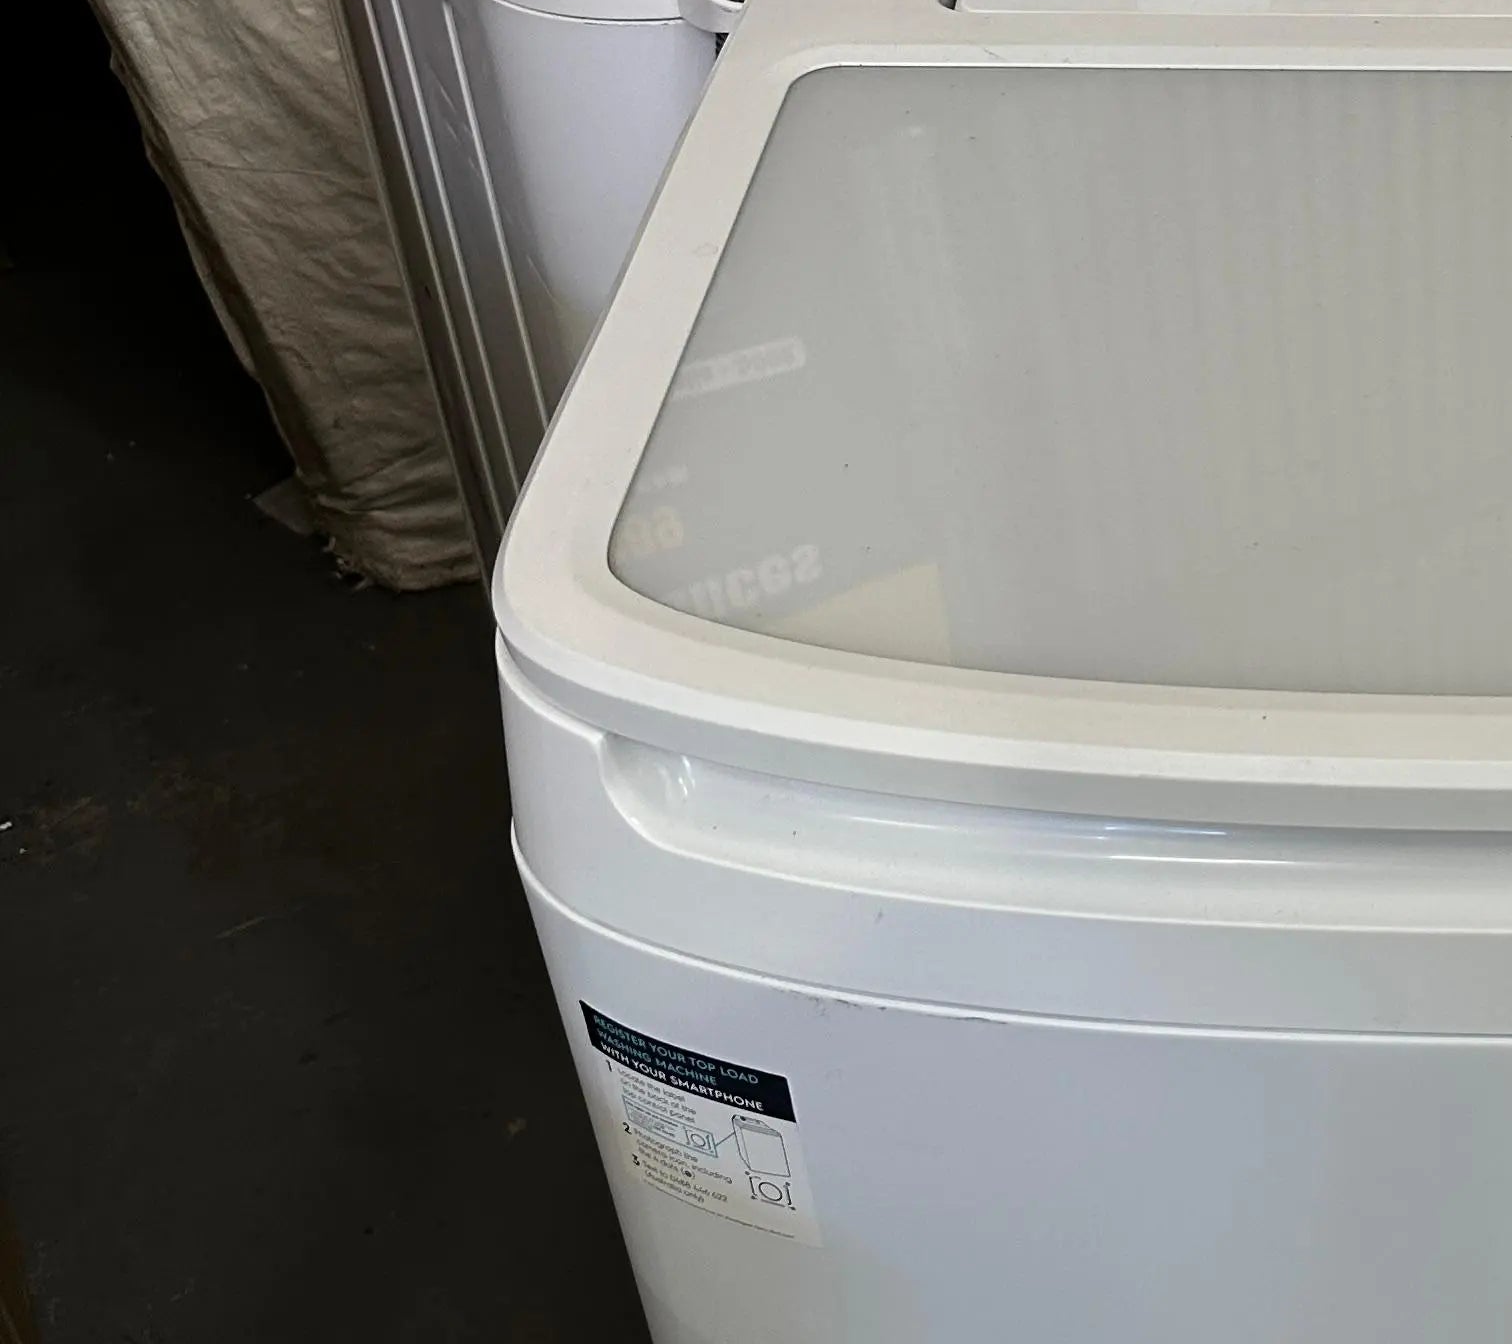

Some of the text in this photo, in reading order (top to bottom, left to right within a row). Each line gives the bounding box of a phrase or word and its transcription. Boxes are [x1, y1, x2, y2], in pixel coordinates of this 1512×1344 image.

[601, 1042, 630, 1064] WITH
[632, 1060, 667, 1081] YOUR
[669, 1075, 764, 1112] SMARTPHONE
[649, 1043, 686, 1064] YOUR
[690, 1057, 716, 1072] TOP
[719, 1066, 759, 1084] LOAD
[655, 1059, 718, 1086] MACHINE
